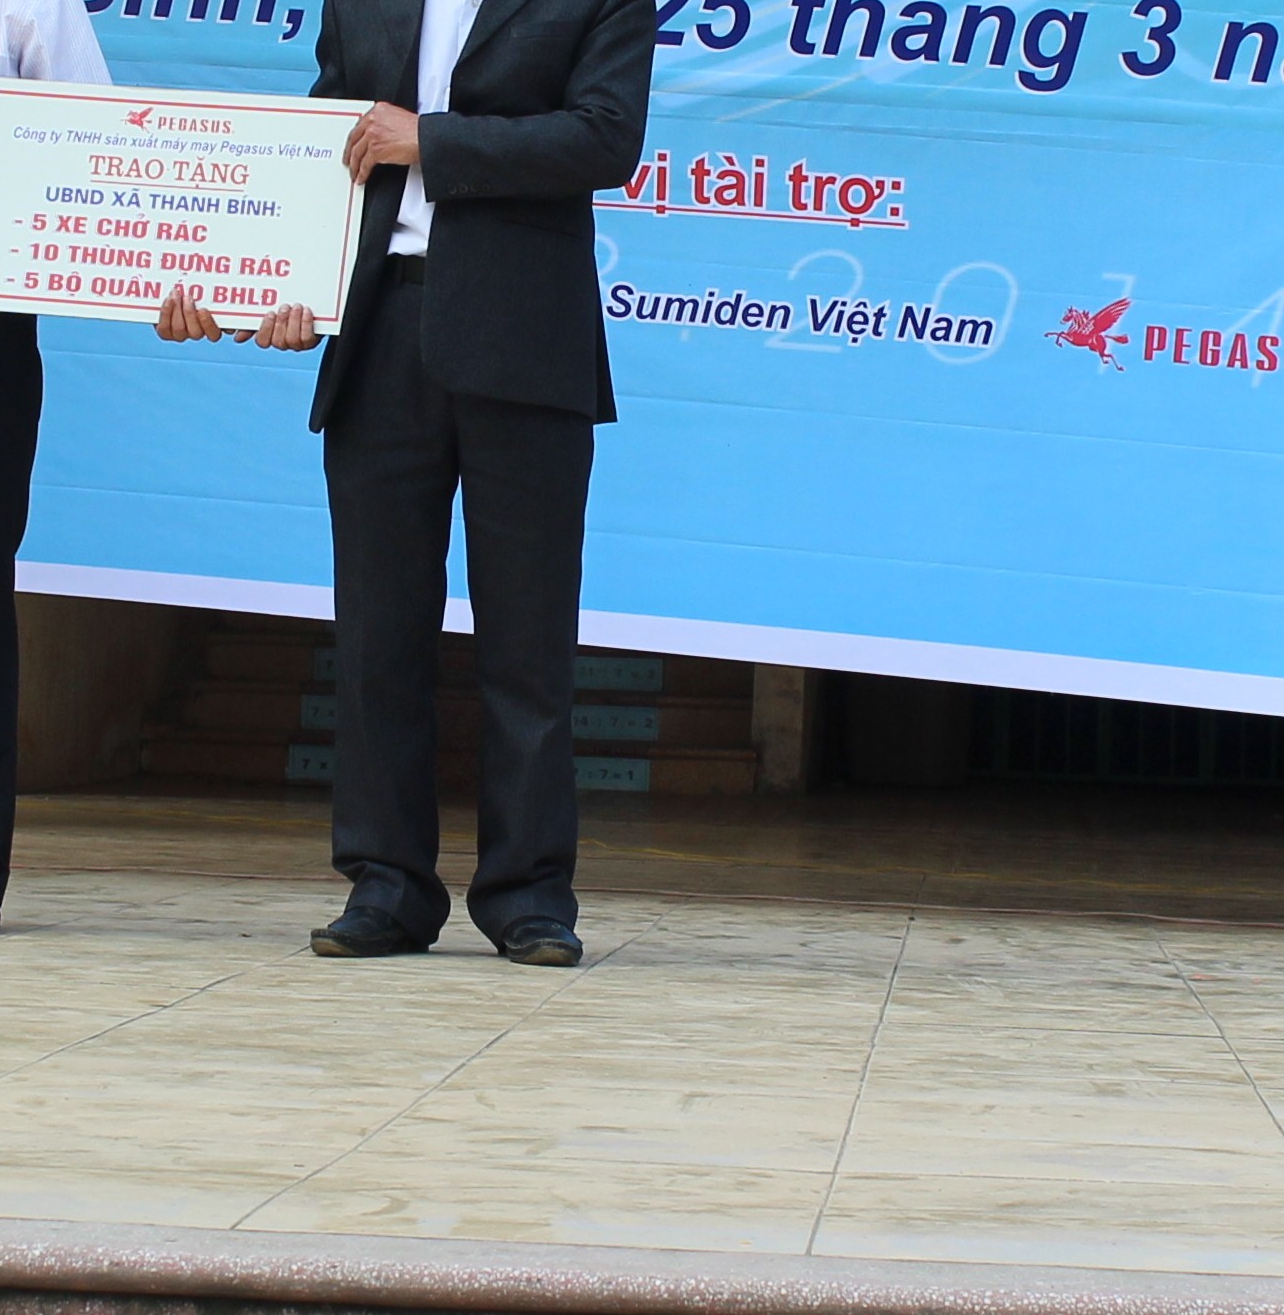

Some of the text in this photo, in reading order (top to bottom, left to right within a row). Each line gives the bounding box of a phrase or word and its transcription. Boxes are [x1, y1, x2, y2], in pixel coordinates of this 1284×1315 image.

[157, 116, 231, 134] PEGASUS
[14, 126, 46, 143] Công
[49, 129, 63, 144] ty
[66, 130, 102, 145] TNHH
[130, 133, 158, 149] xuất
[161, 136, 188, 153] máy
[190, 141, 216, 155] may
[219, 141, 273, 159] Pegasus
[277, 143, 302, 160] Việt
[304, 146, 333, 159] Nam
[89, 155, 250, 190] TRAO TẶNG
[689, 151, 768, 208] tài
[787, 157, 905, 228] trợ:
[45, 186, 282, 217] UBND XÃ THANH BÍNH:
[32, 213, 47, 230] 5
[56, 214, 88, 234] XE
[96, 212, 150, 239] CHỞ
[157, 219, 208, 243] RÁC
[30, 242, 59, 262] 10
[68, 243, 152, 269] THÙNG
[161, 251, 231, 276] ĐỰNG
[239, 254, 291, 278] RÁC
[24, 272, 39, 290] 5
[48, 271, 82, 297] BỘ
[91, 273, 162, 300] QUẦN
[212, 285, 279, 307] BHLĐ
[606, 283, 996, 348] Sumiden Việt Nam
